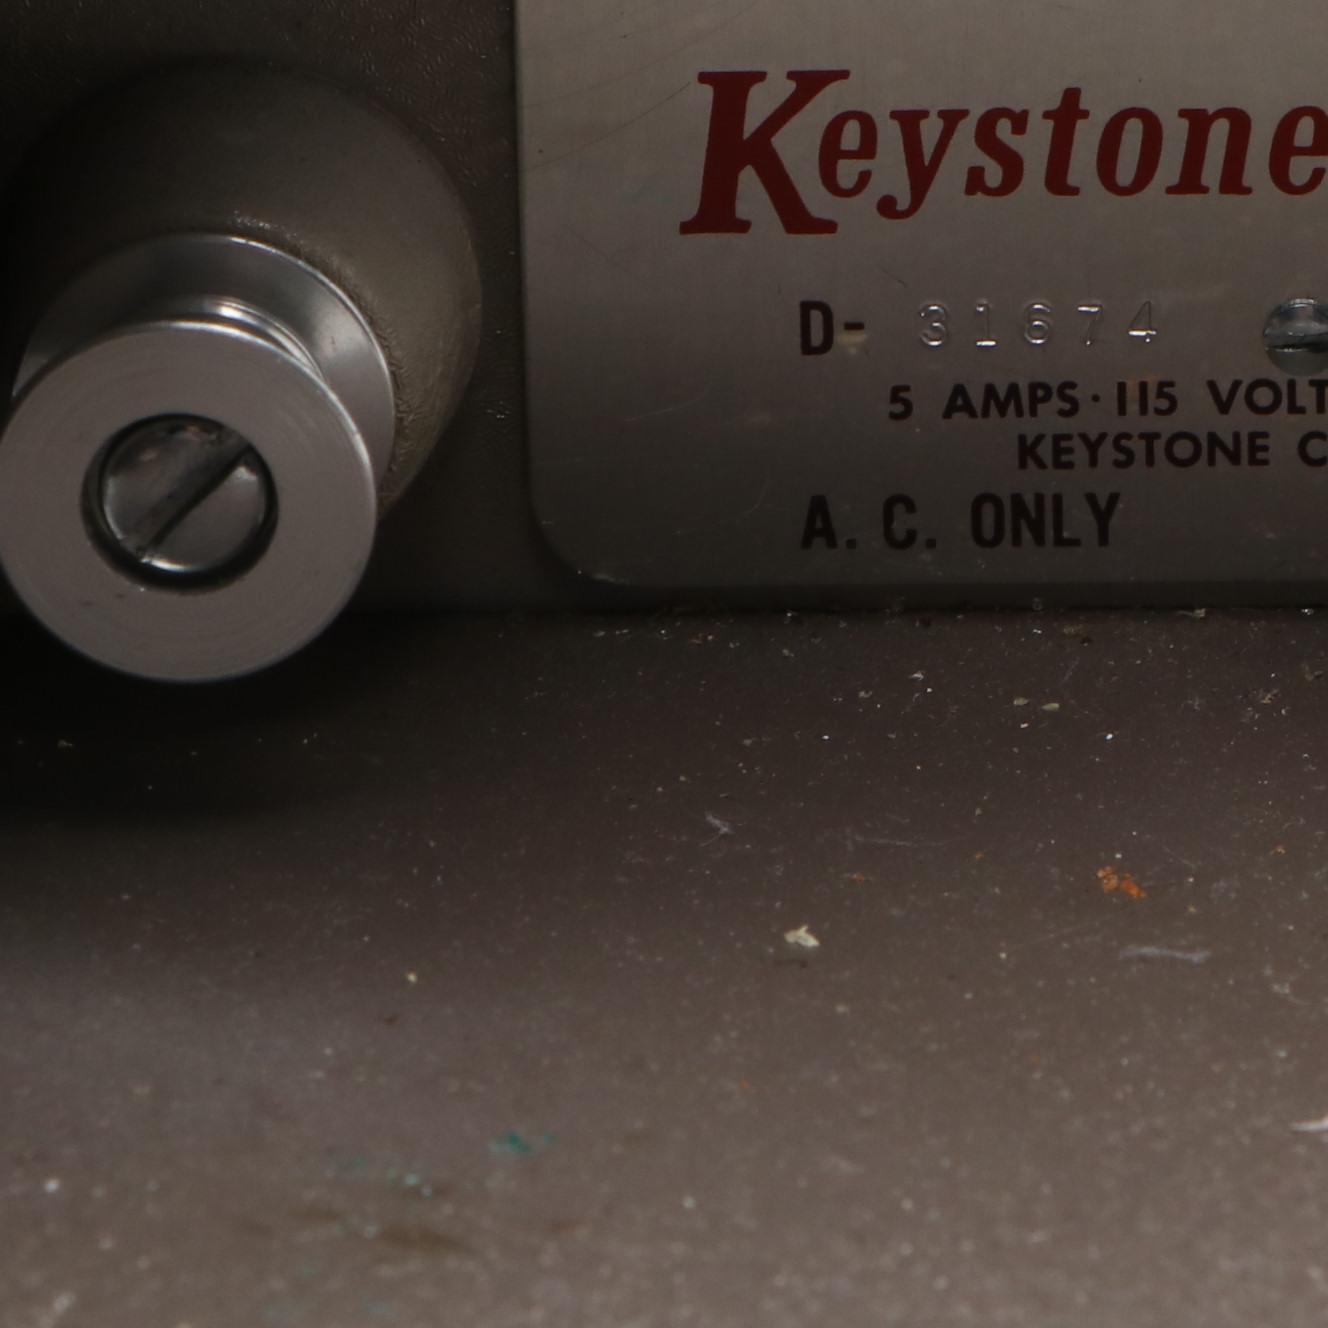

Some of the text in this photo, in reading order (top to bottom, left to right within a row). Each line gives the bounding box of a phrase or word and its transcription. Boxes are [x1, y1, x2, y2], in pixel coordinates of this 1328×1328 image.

[918, 300, 1158, 348] 31674
[888, 384, 914, 421] 5
[1017, 430, 1271, 471] KEYSTONE
[970, 491, 1122, 549] ONLY
